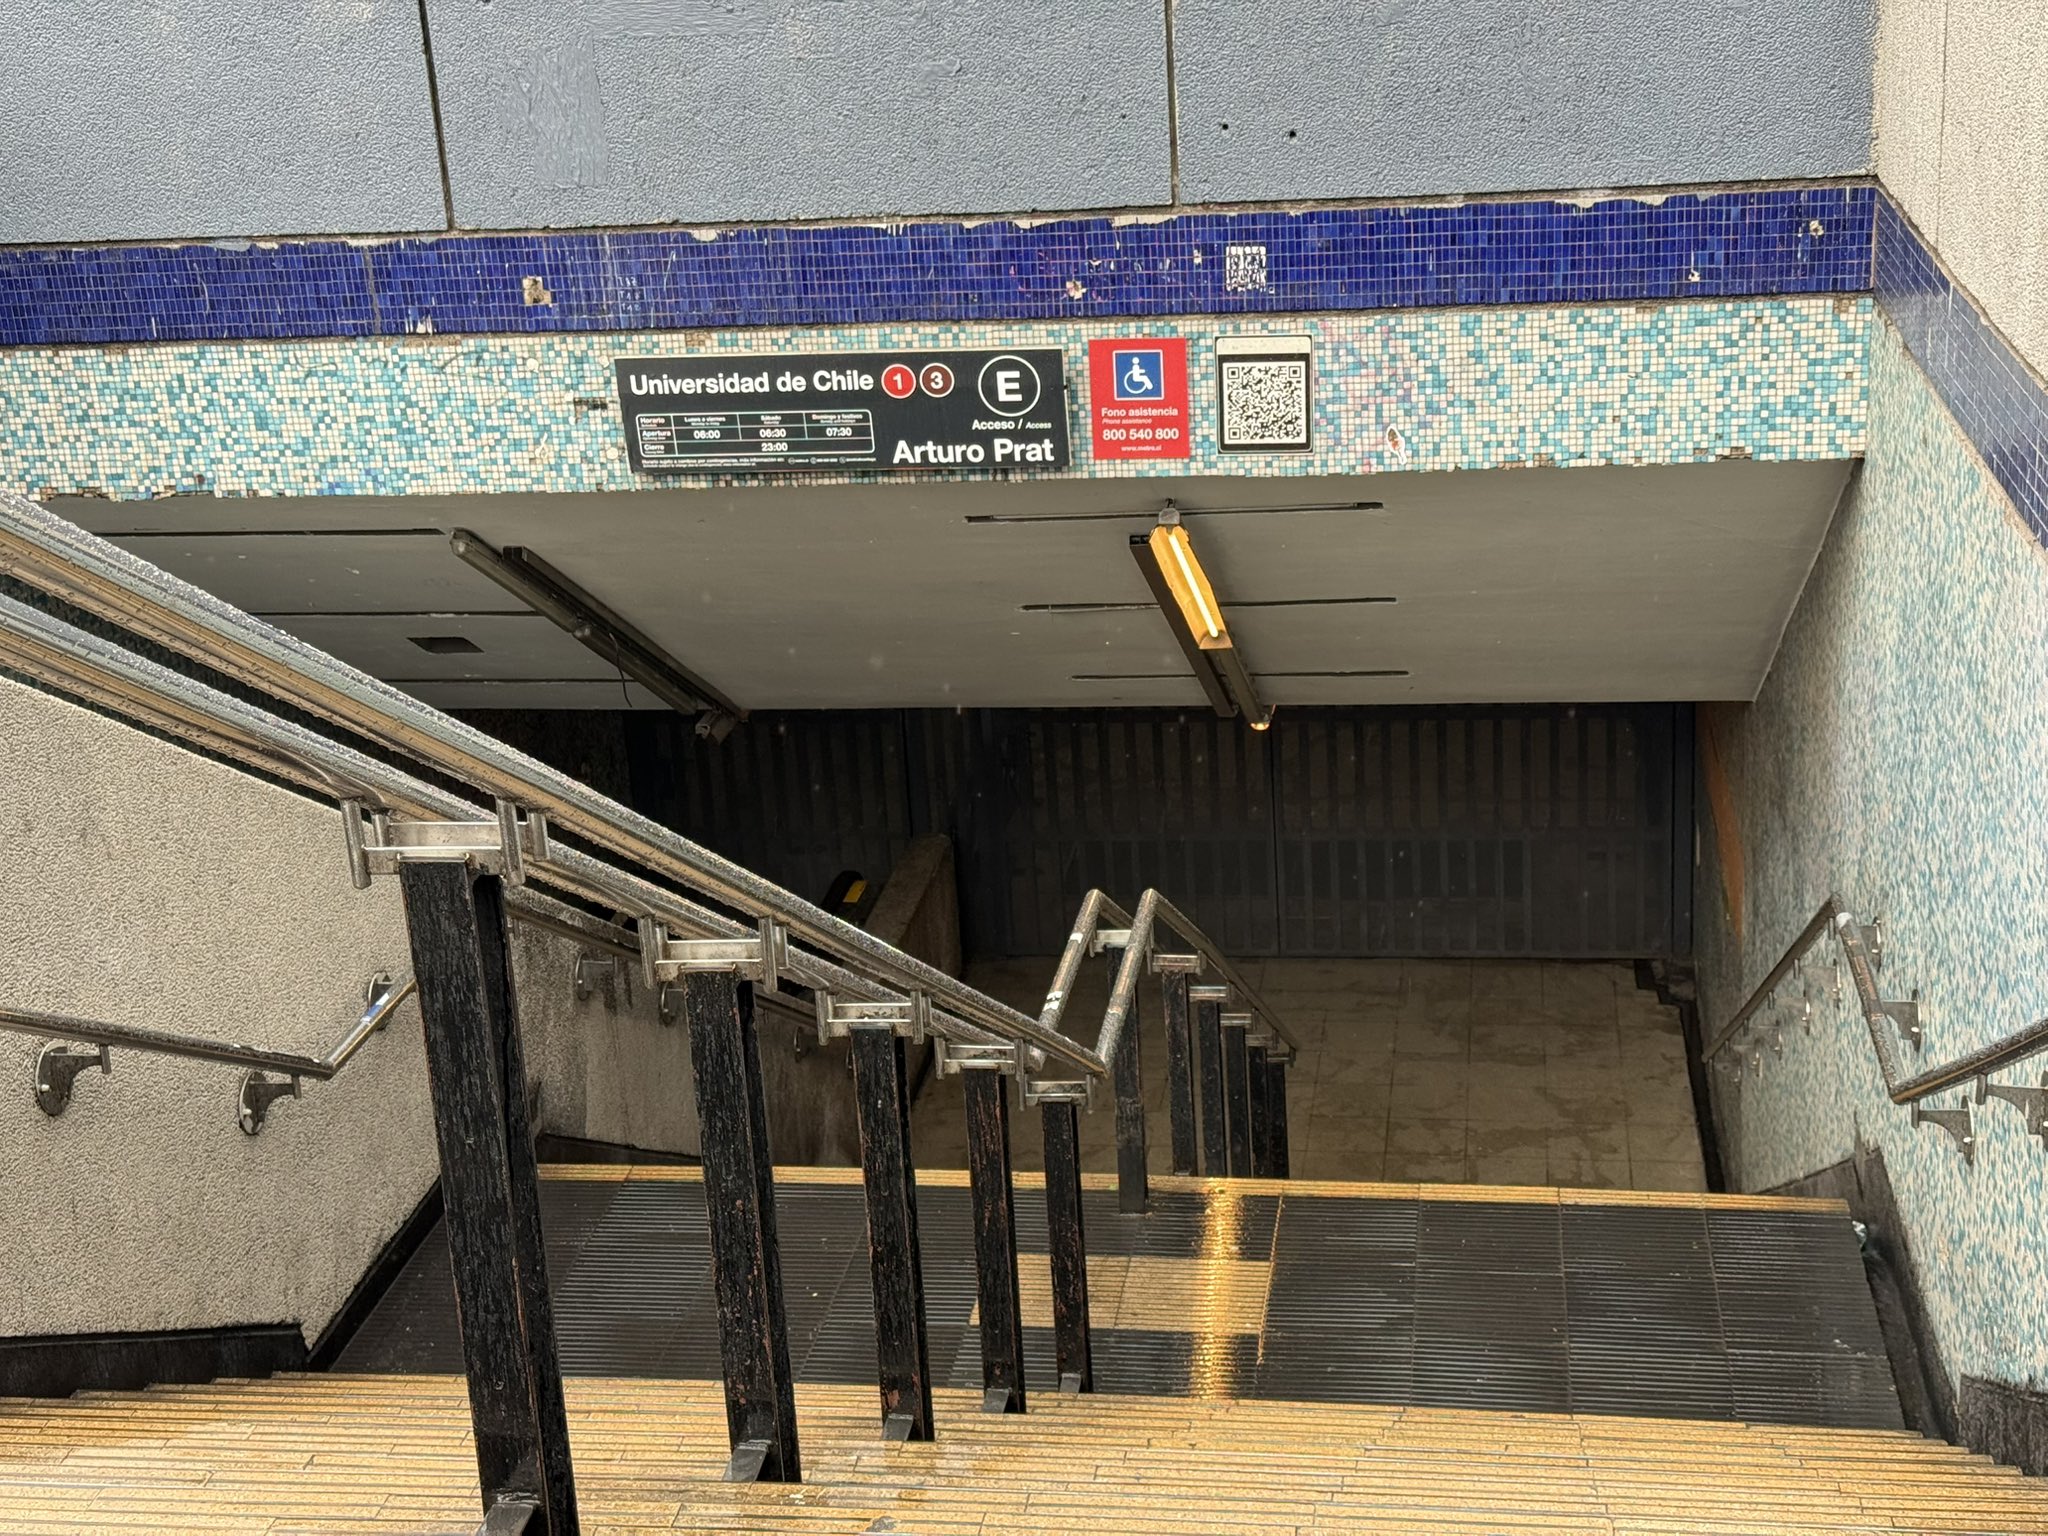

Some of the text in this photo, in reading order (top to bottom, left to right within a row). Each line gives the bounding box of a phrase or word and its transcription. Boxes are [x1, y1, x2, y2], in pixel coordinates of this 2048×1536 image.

[629, 369, 944, 395] Universidad de Chile 1 3
[996, 370, 1023, 402] E
[1101, 406, 1179, 417] Fono asistencia
[972, 420, 1015, 430] Acceso
[1025, 421, 1052, 429] Access
[693, 429, 721, 439] 06:00
[759, 428, 787, 438] 06:30
[826, 427, 852, 437] 07:30
[1102, 427, 1179, 440] 800 540 800
[761, 442, 789, 452] 23:00
[893, 438, 1055, 464] Arturo Prat
